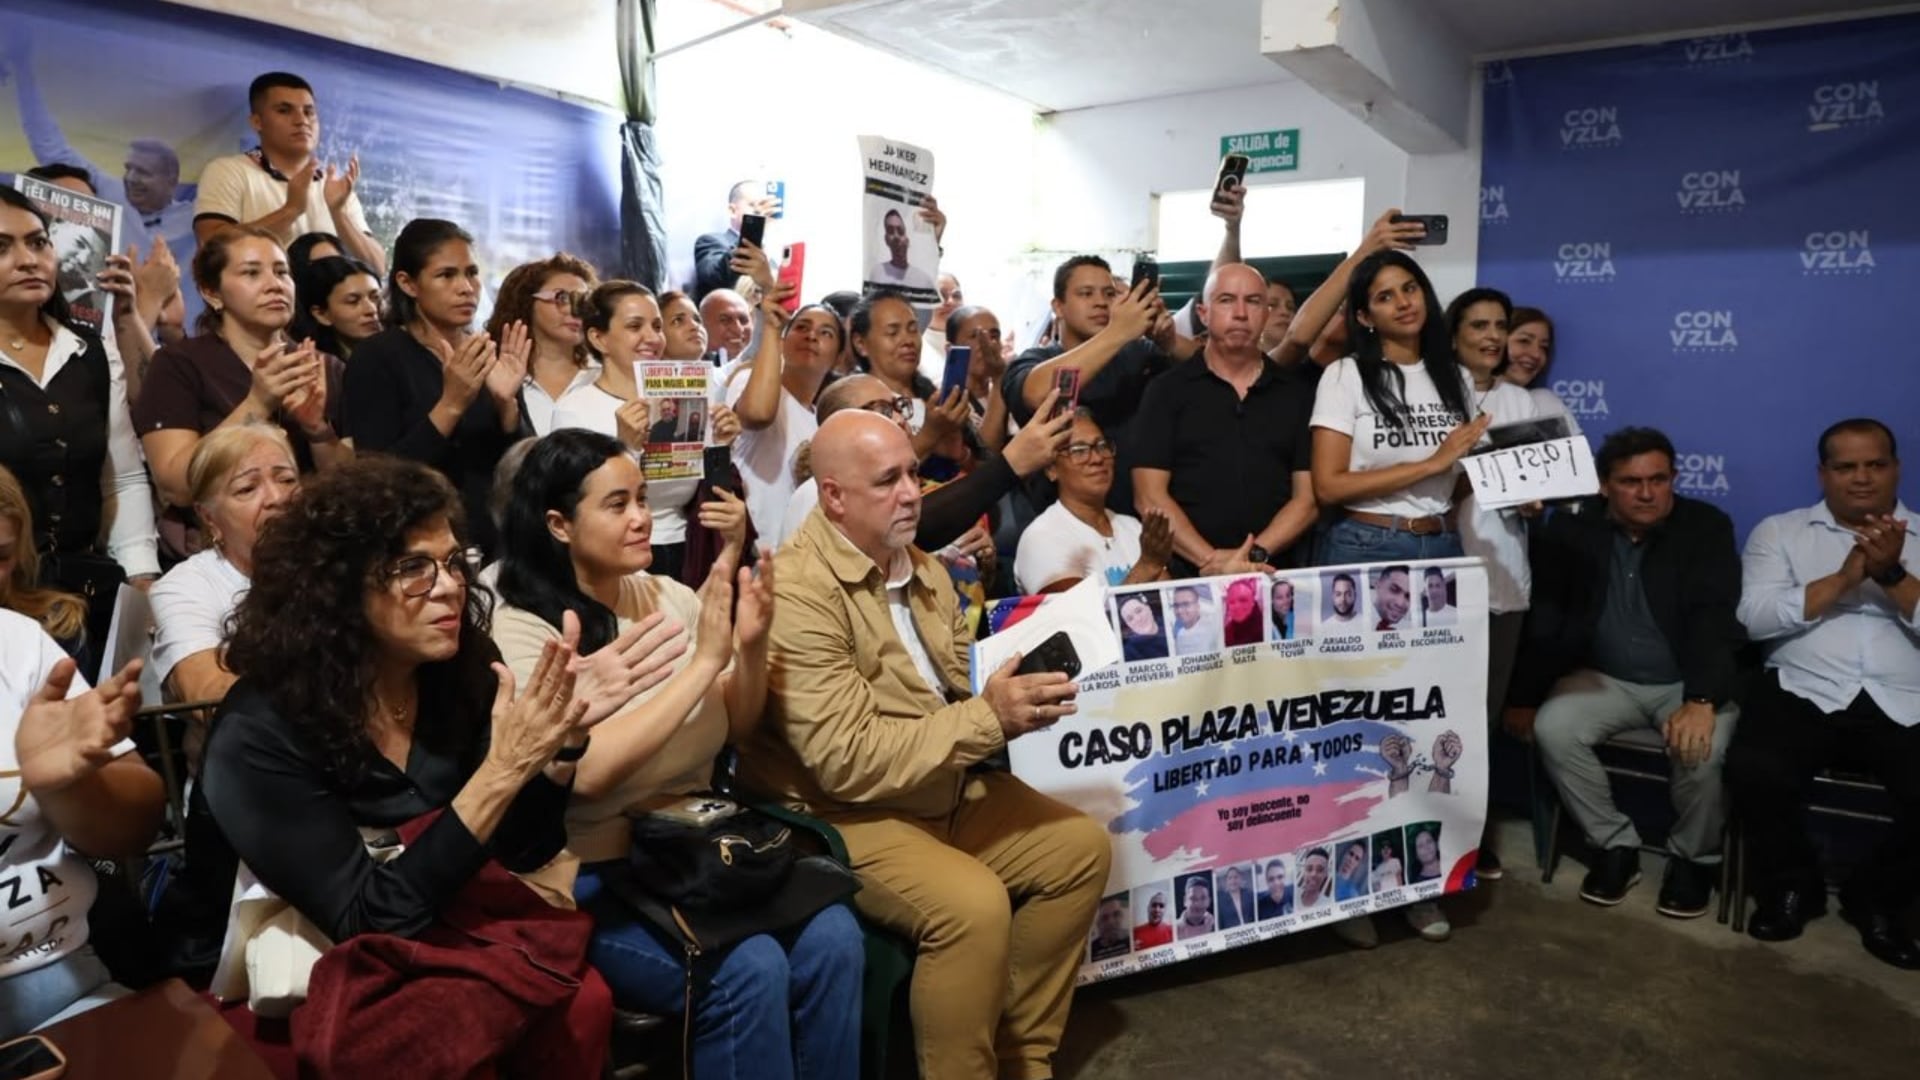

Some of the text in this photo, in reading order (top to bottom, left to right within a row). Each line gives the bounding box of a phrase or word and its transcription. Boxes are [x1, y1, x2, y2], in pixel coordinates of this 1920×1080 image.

[1814, 81, 1879, 104] CON
[1564, 106, 1617, 126] CON
[1808, 101, 1884, 122] VZLA
[1229, 133, 1290, 152] SALIDA de
[1559, 124, 1622, 145] VZLA
[868, 158, 928, 185] HERNANDEZ
[1682, 170, 1740, 190] CON
[50, 191, 70, 207] NO
[73, 199, 90, 214] ES
[1676, 188, 1745, 209] VZLA
[1805, 230, 1869, 251] CON
[1558, 243, 1611, 260] CON
[1800, 250, 1875, 269] VZLA
[1554, 260, 1616, 277] VZLA
[1675, 310, 1733, 329] CON
[1669, 329, 1738, 346] VZLA
[1553, 380, 1604, 397] CON
[1565, 398, 1608, 415] ZLA
[1323, 636, 1361, 645] ARIALDO
[1382, 632, 1400, 641] JOEL
[1411, 635, 1464, 648] ESCORIHUELA
[1423, 628, 1452, 638] RAFAEL
[1231, 646, 1256, 658] JORGE
[1319, 643, 1365, 653] CAMARGO
[1378, 640, 1406, 650] BRAVO
[1177, 660, 1223, 675] RODRIGUEZ
[1181, 652, 1221, 666] JOHANNY
[1232, 655, 1257, 665] MATA
[1129, 662, 1168, 674] MARCOS
[1096, 679, 1121, 690] ROSA
[1125, 671, 1174, 685] ECHEVERRI
[1058, 684, 1447, 770] CASO PLAZA VENEZUELA
[1154, 732, 1364, 793] LIBERTAD PARA TODOS
[1217, 794, 1310, 821] Yo soy inocente, no
[1227, 807, 1302, 832] soy delincuente
[1138, 947, 1175, 963] ORLANDO
